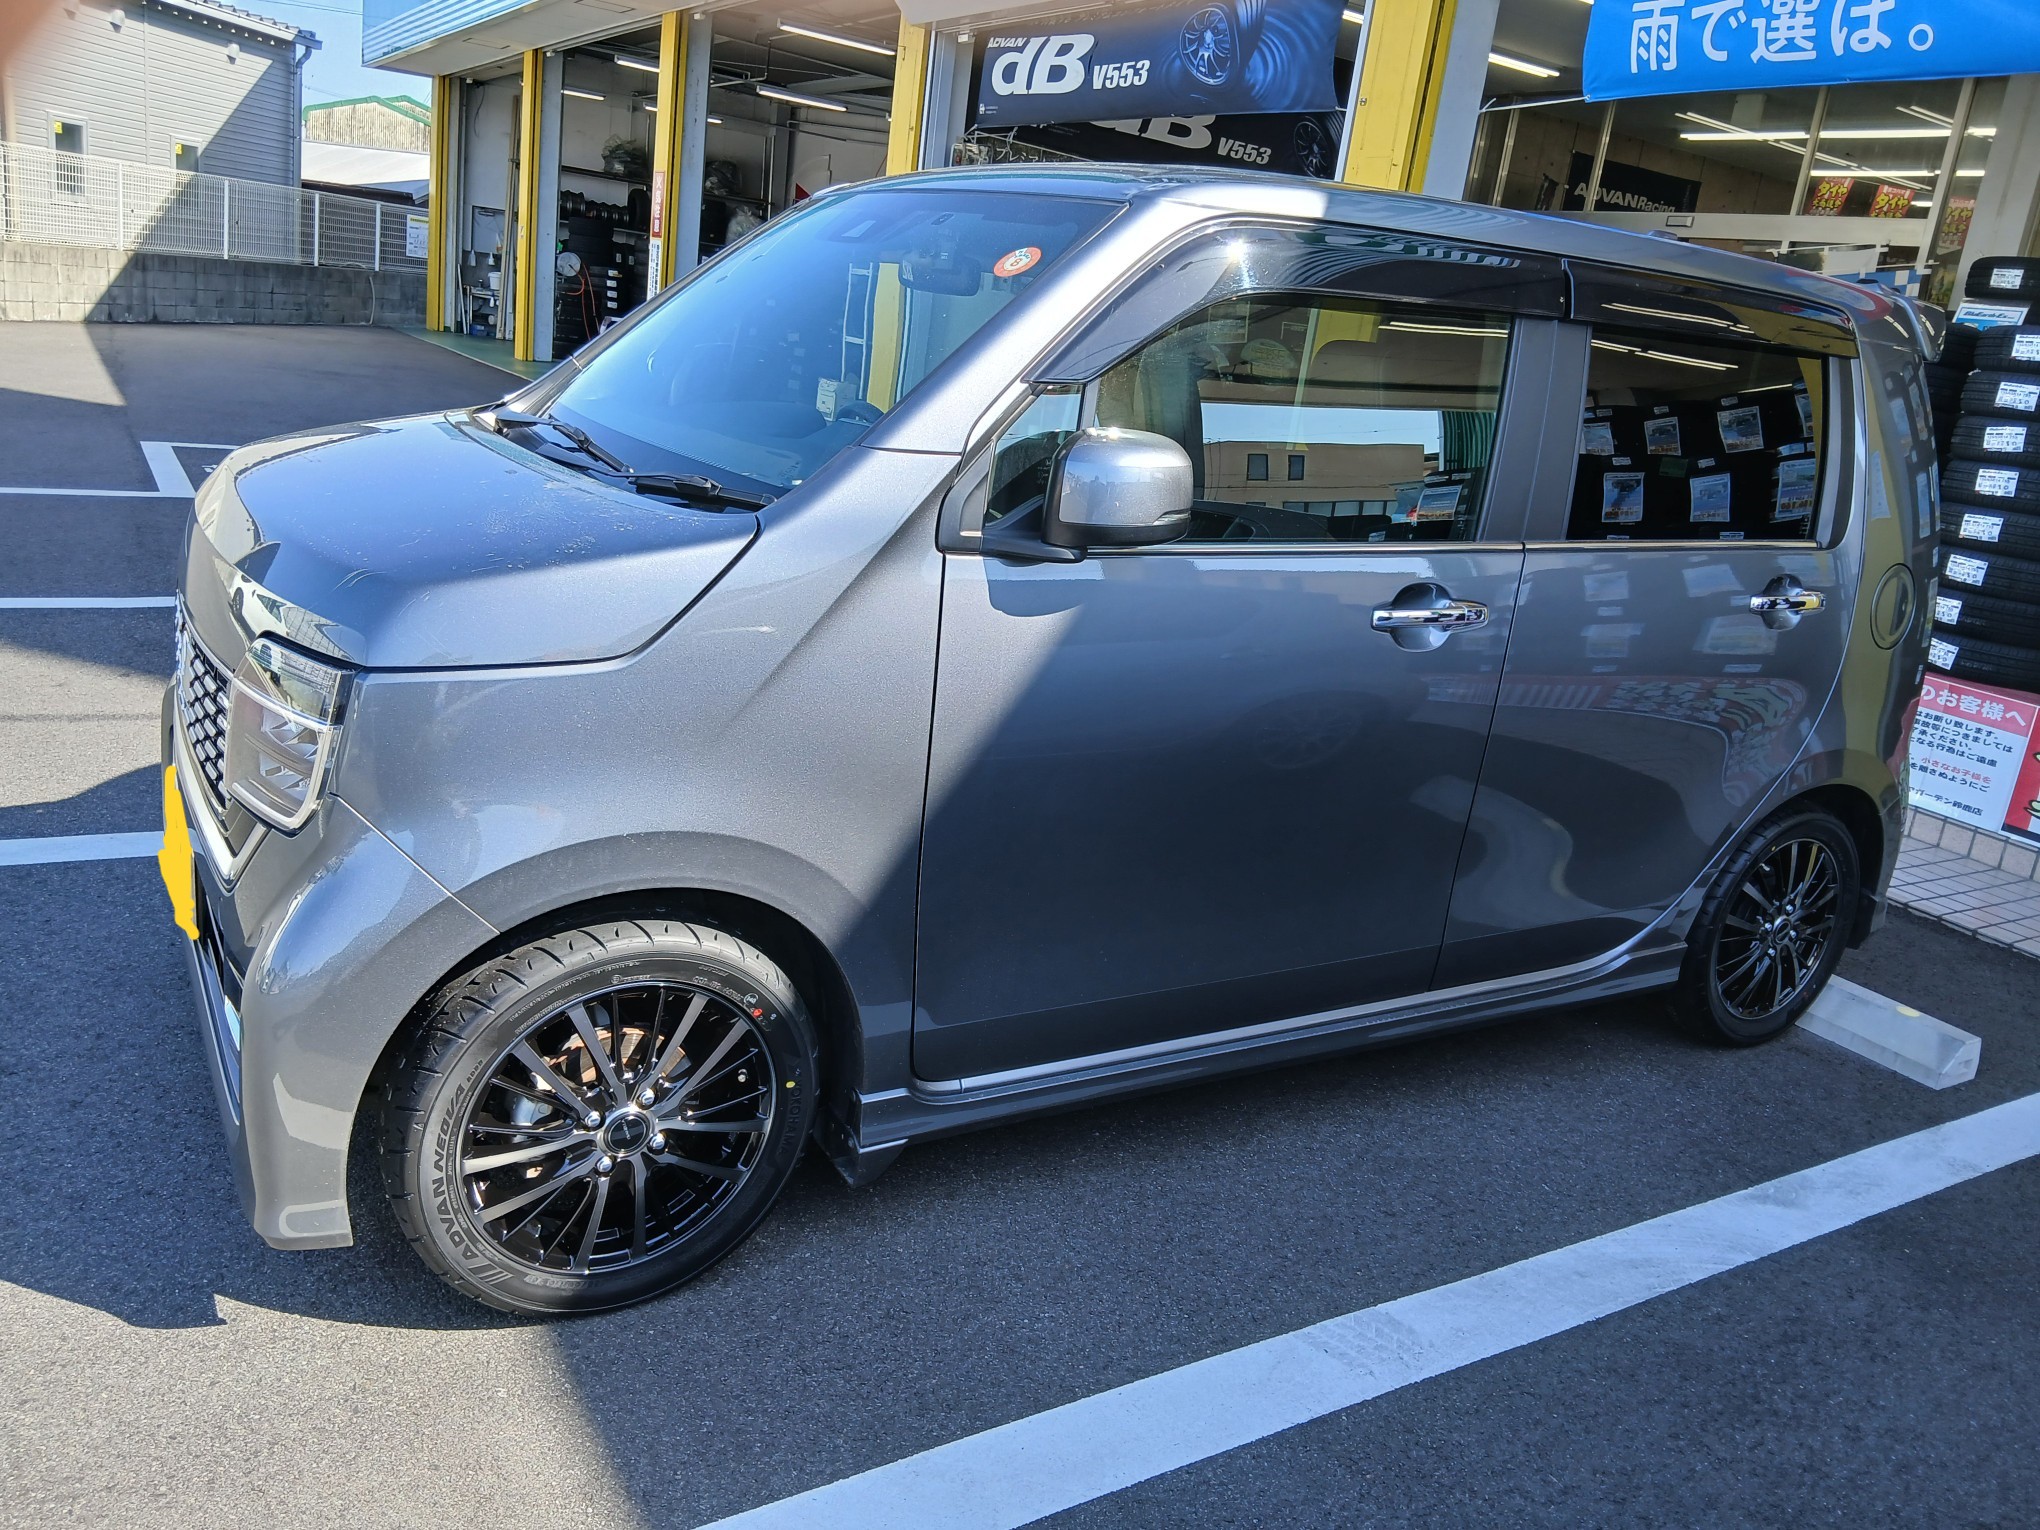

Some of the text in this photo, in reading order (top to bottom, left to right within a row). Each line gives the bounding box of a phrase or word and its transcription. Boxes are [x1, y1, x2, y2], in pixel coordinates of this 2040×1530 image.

[987, 37, 1028, 48] ADVAN
[991, 33, 1151, 96] dB V553
[1217, 137, 1272, 165] V553
[1874, 193, 1910, 209] タイヤ
[434, 1083, 464, 1172] NEOVA
[433, 1178, 480, 1261] ADVAN
